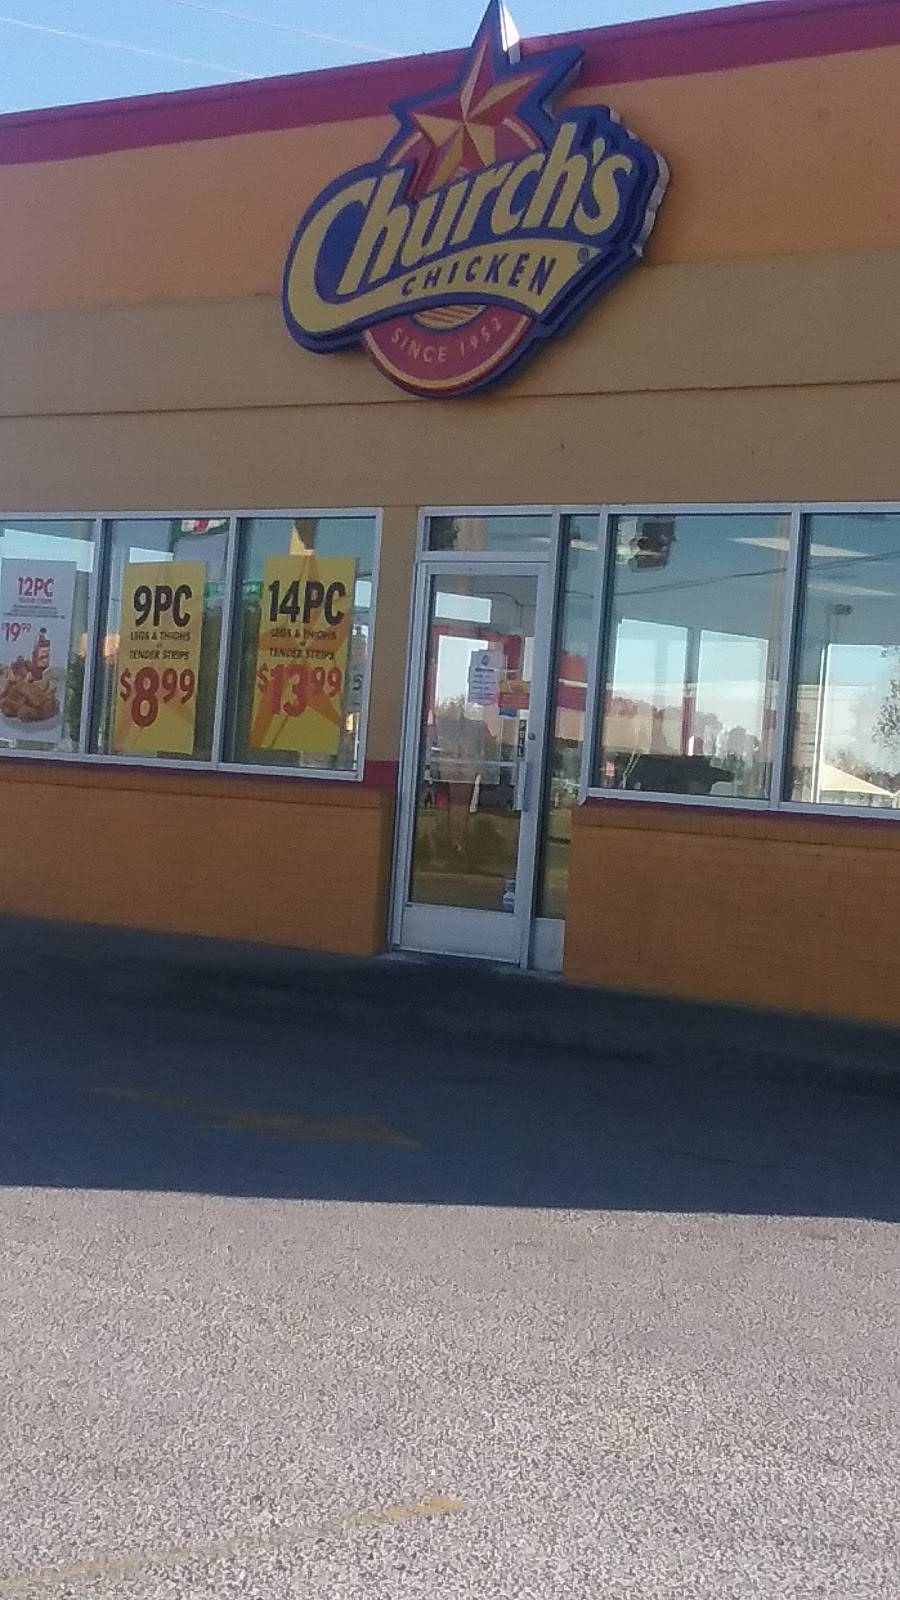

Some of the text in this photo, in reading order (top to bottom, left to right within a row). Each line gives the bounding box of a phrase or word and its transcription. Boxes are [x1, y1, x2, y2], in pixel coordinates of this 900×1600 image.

[287, 121, 633, 332] Church's
[402, 252, 556, 297] CHICKEN
[391, 317, 502, 363] SINCE 1952
[17, 576, 55, 598] 12PC
[133, 584, 192, 628] 9PC
[268, 580, 346, 626] 14PC
[130, 649, 190, 661] TENDER STRIPS
